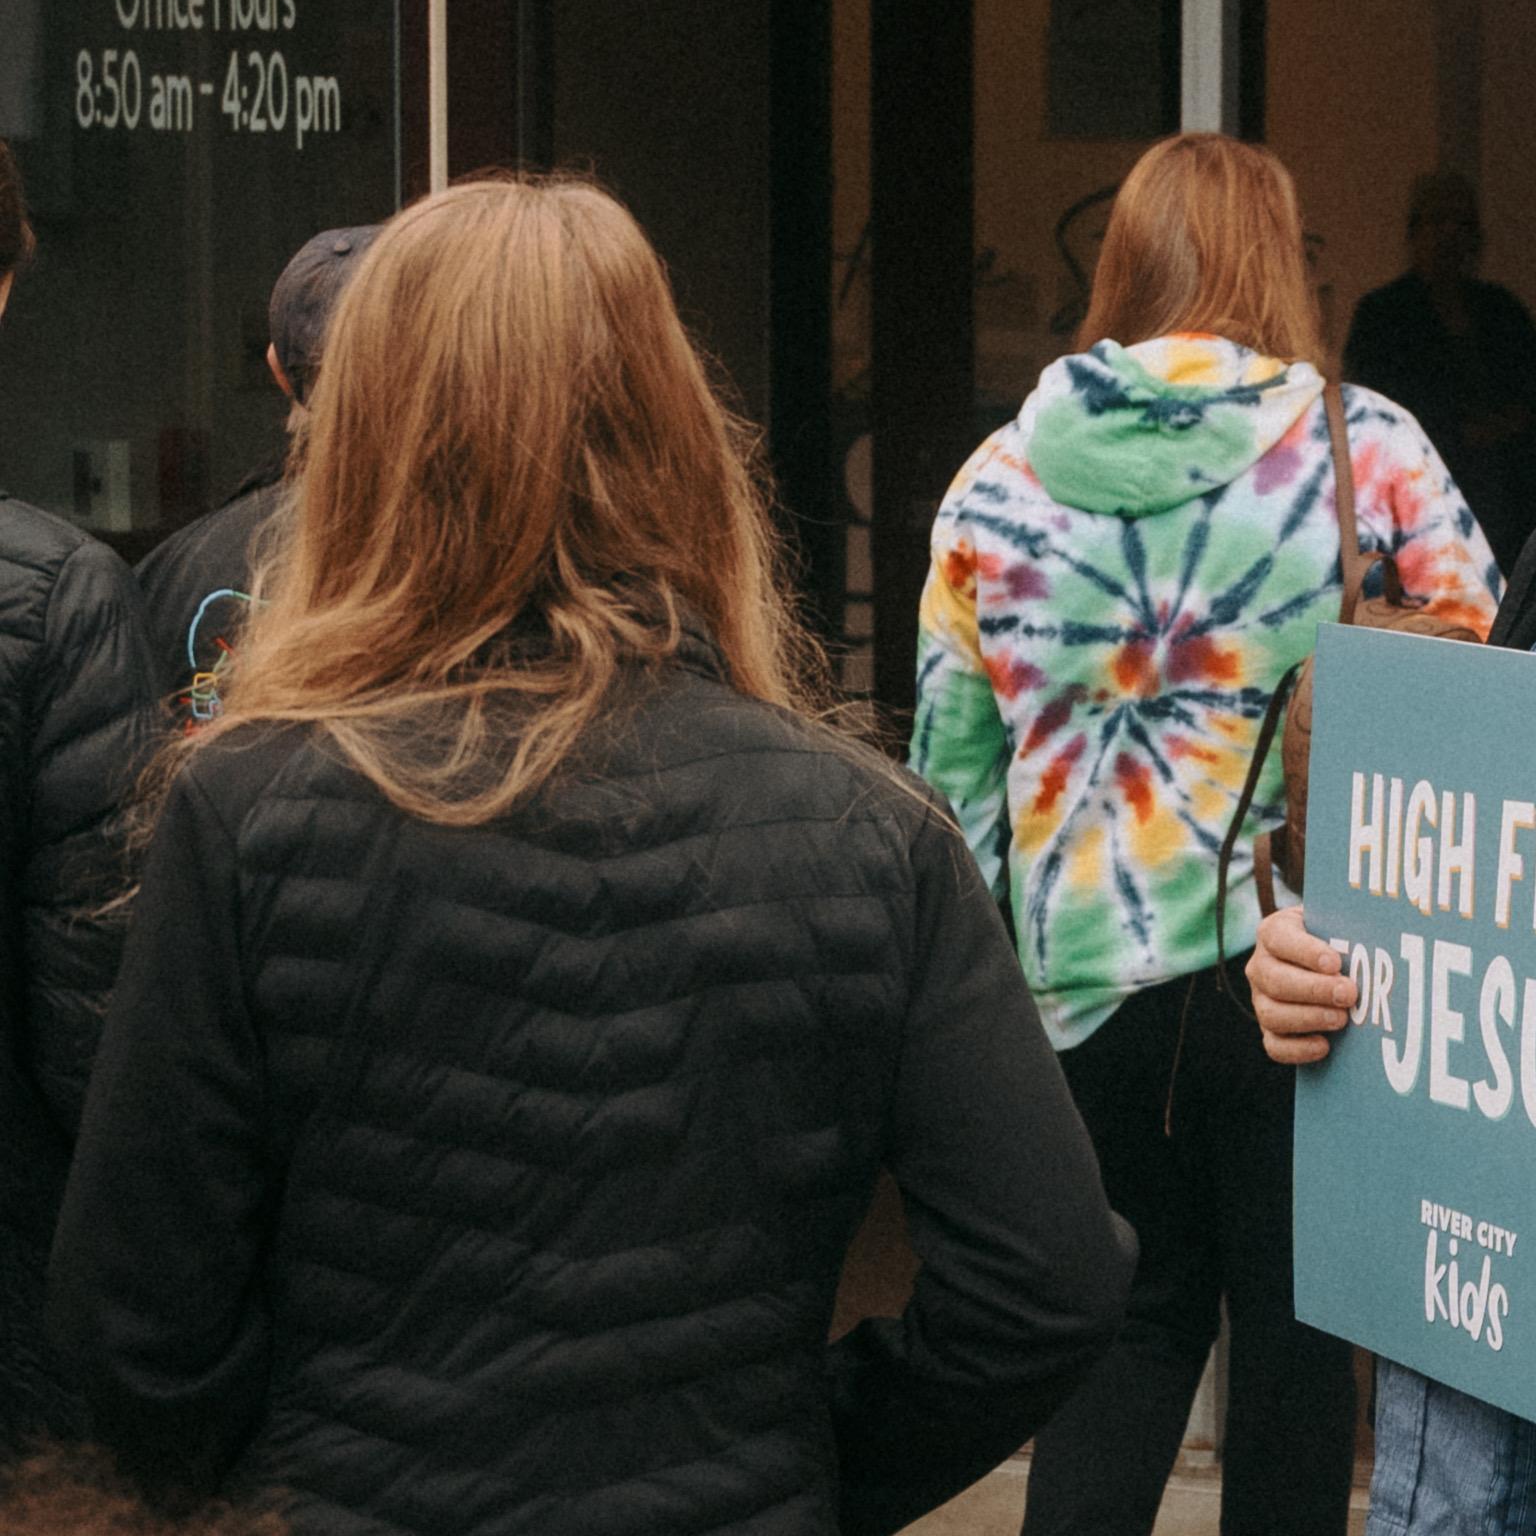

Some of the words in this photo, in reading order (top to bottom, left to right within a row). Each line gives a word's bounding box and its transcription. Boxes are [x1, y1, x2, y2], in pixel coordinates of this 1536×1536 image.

[75, 50, 141, 130] 8:50
[150, 75, 193, 131] am
[222, 51, 288, 132] 4:20
[296, 76, 341, 150] pm
[1348, 771, 1475, 918] HIGH
[1329, 937, 1394, 1033] OR
[1421, 1199, 1472, 1241] RIVER
[1477, 1221, 1517, 1257] CITY
[1425, 1229, 1508, 1351] kids
